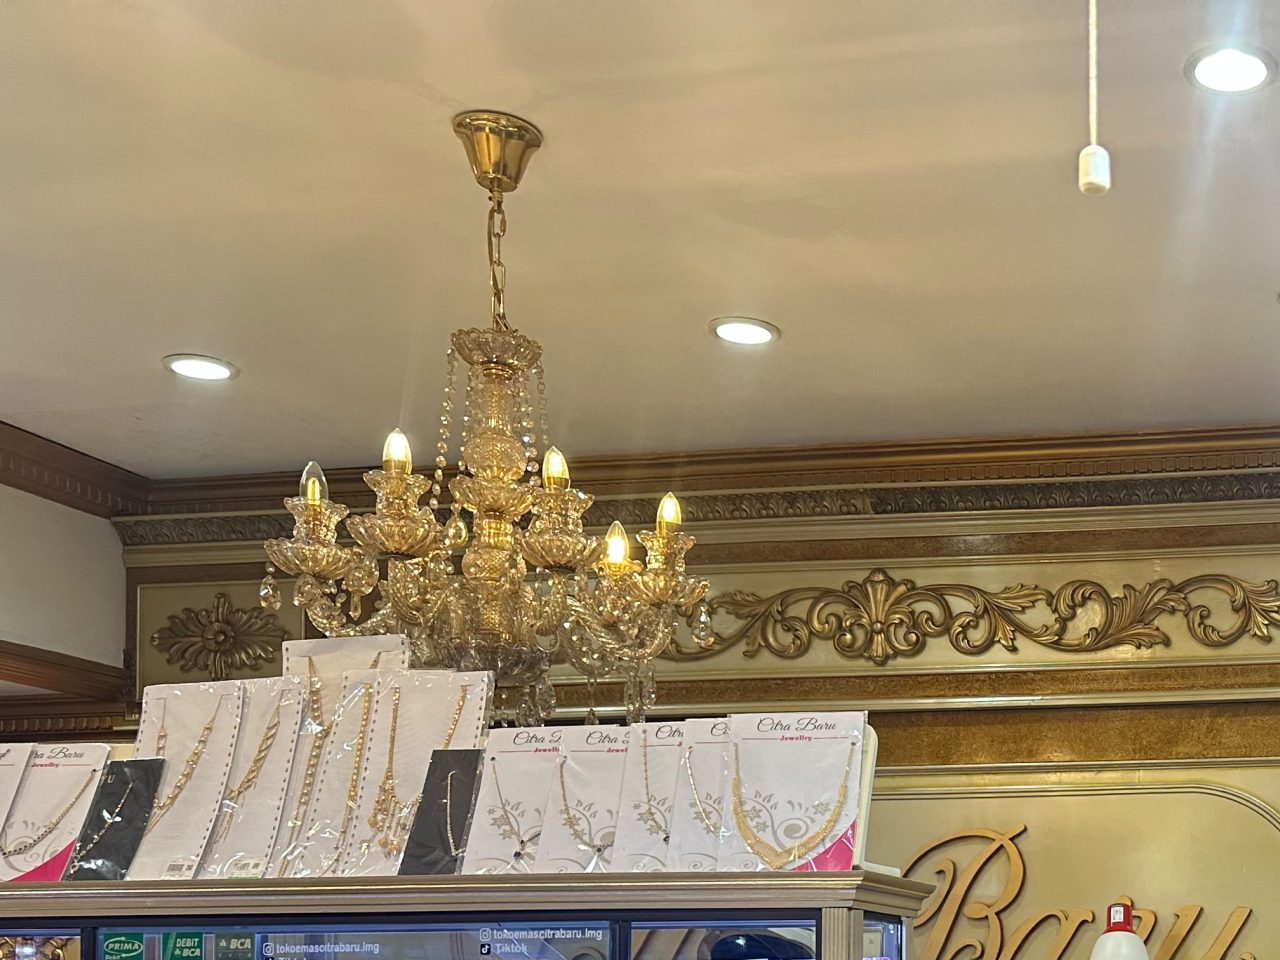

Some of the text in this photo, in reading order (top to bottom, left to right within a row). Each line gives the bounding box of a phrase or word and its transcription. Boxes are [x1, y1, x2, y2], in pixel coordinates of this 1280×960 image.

[757, 717, 837, 732] Citra Baru
[513, 731, 545, 745] Citra
[585, 731, 618, 745] Citra
[655, 725, 684, 739] Citr
[176, 937, 199, 947] DEBIT
[229, 938, 252, 949] BCA
[182, 948, 201, 957] BCA
